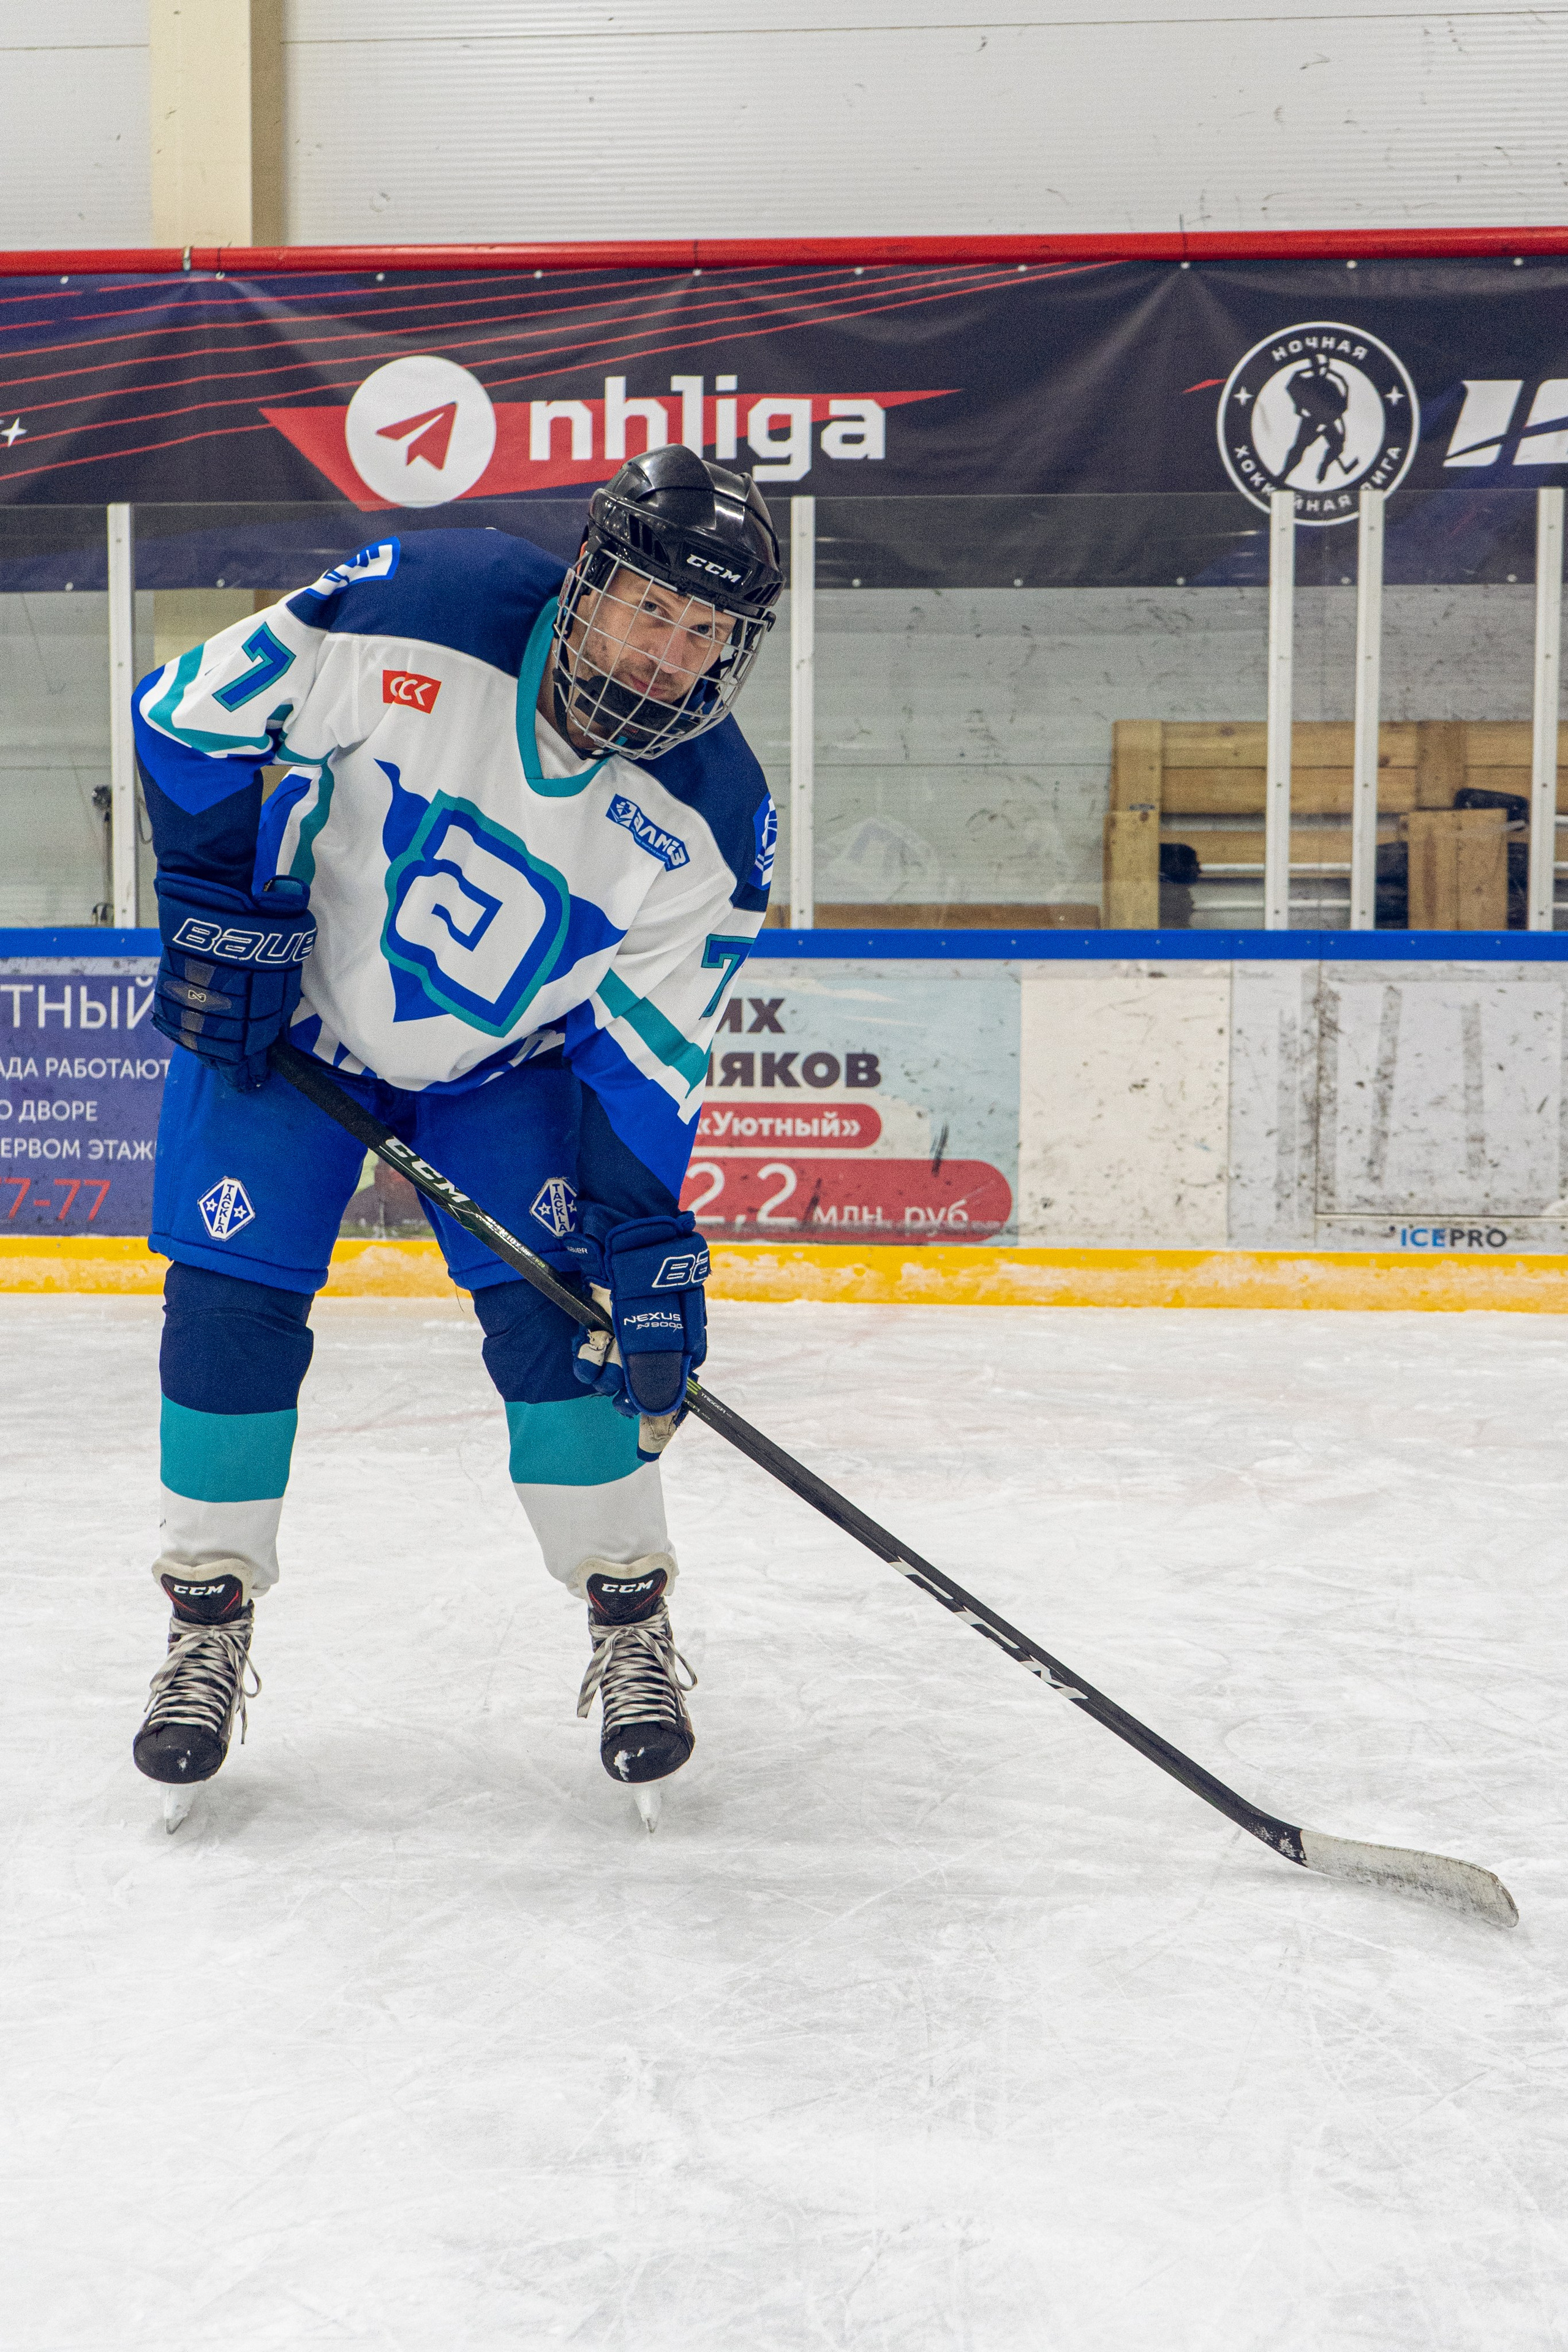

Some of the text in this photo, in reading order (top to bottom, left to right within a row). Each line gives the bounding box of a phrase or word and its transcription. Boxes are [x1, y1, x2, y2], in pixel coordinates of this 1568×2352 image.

[1272, 336, 1368, 361] НОЧНАЯ
[529, 375, 886, 482] nhliga
[1234, 445, 1352, 512] ХОККЙНАЯ
[687, 554, 742, 583] CCM
[212, 621, 297, 713] 7
[173, 918, 317, 963] BAUE
[698, 934, 756, 1021] 7
[45, 1057, 171, 1080] РАБОТАЮТ
[705, 1051, 882, 1088] ЯКОВ
[18, 1100, 98, 1123] ДВОРЕ
[697, 1110, 861, 1137] «Уютный»
[0, 1137, 157, 1161] ЕРВОМ ЭТАЖ
[385, 1136, 471, 1204] CCM
[0, 1177, 111, 1221] 7-77
[214, 1183, 235, 1234] TACKLA
[552, 1183, 568, 1232] TACKLA
[687, 1162, 797, 1231] 2,2
[1401, 1227, 1507, 1248] ICEPRO
[624, 1312, 681, 1325] NEXUS
[173, 1584, 225, 1596] CCM
[601, 1580, 654, 1593] CCM
